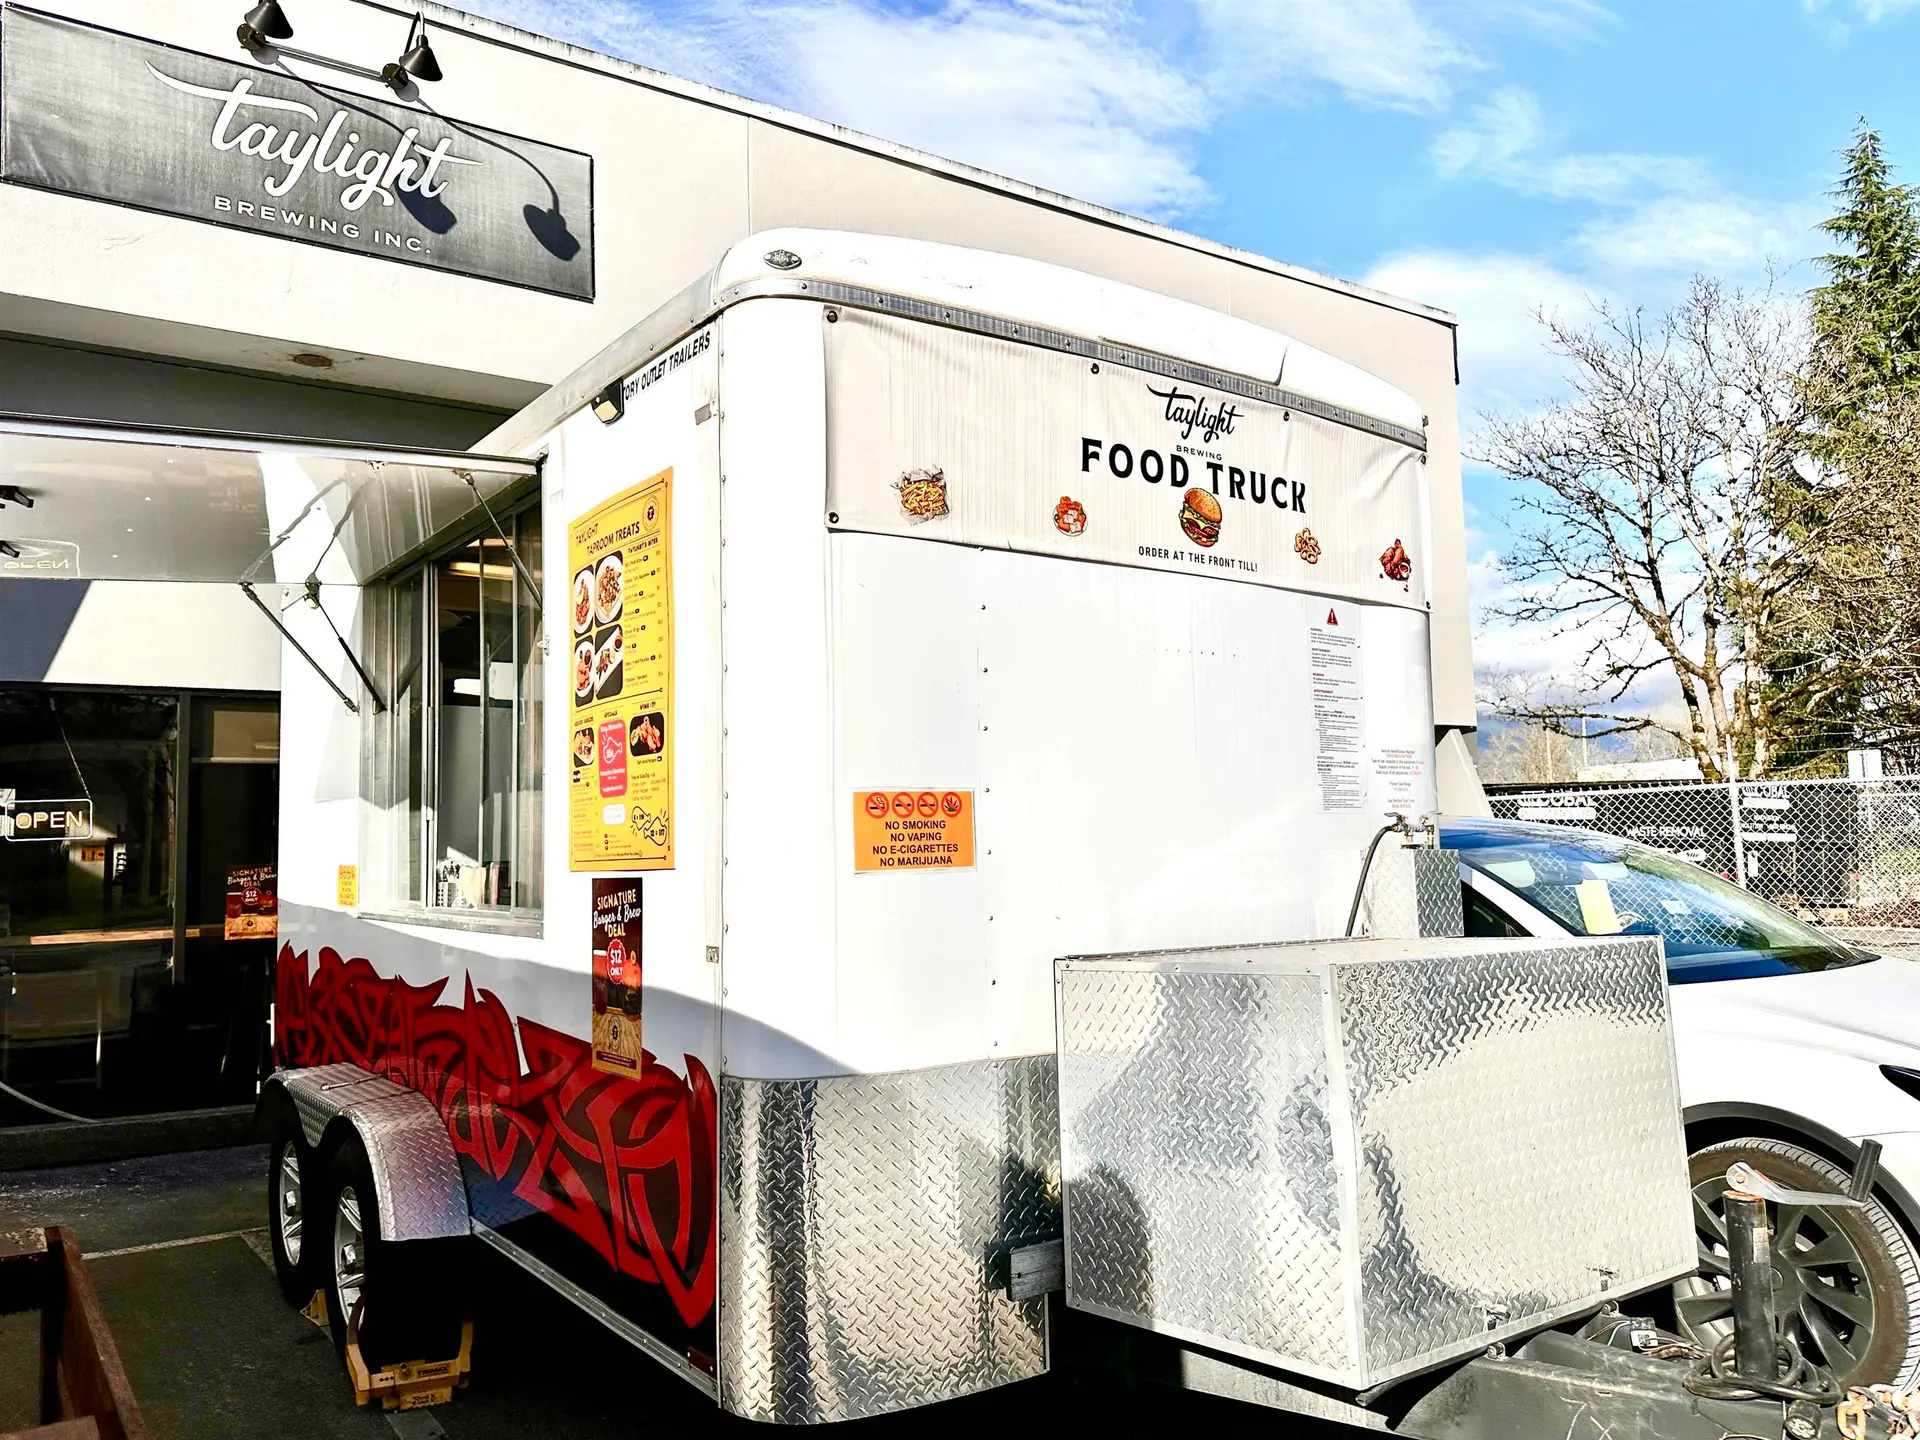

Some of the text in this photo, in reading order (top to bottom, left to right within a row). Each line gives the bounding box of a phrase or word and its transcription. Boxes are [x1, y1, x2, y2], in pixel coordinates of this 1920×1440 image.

[145, 59, 484, 211] taylight
[213, 196, 432, 254] BREWING INC.
[641, 359, 667, 390] OUTLET
[669, 331, 711, 371] TRAILERS
[1146, 383, 1244, 443] taylight
[1176, 445, 1223, 461] BREWING
[1081, 437, 1306, 514] FOOD TRUCK
[587, 521, 640, 555] TAPROOM TREATS
[1138, 546, 1258, 572] ORDER AT THE FRONT TILL!
[15, 811, 83, 829] OPEN
[885, 820, 946, 830] NO SMOKING
[890, 832, 942, 842] NO VAPING
[1626, 825, 1706, 837] WASTE REMOVAL
[872, 843, 959, 855] NO E-CIGARETTES
[880, 855, 953, 867] NO MARIJUANA
[227, 876, 251, 885] Burger
[260, 872, 277, 881] Brew
[232, 866, 272, 877] SIGNATURE
[245, 890, 257, 898] $12
[597, 889, 637, 910] SIGNATURE
[593, 910, 616, 932] Burger
[624, 904, 641, 923] Brew
[608, 922, 626, 937] DEAL
[610, 948, 622, 965] $12
[610, 966, 623, 976] ONLY
